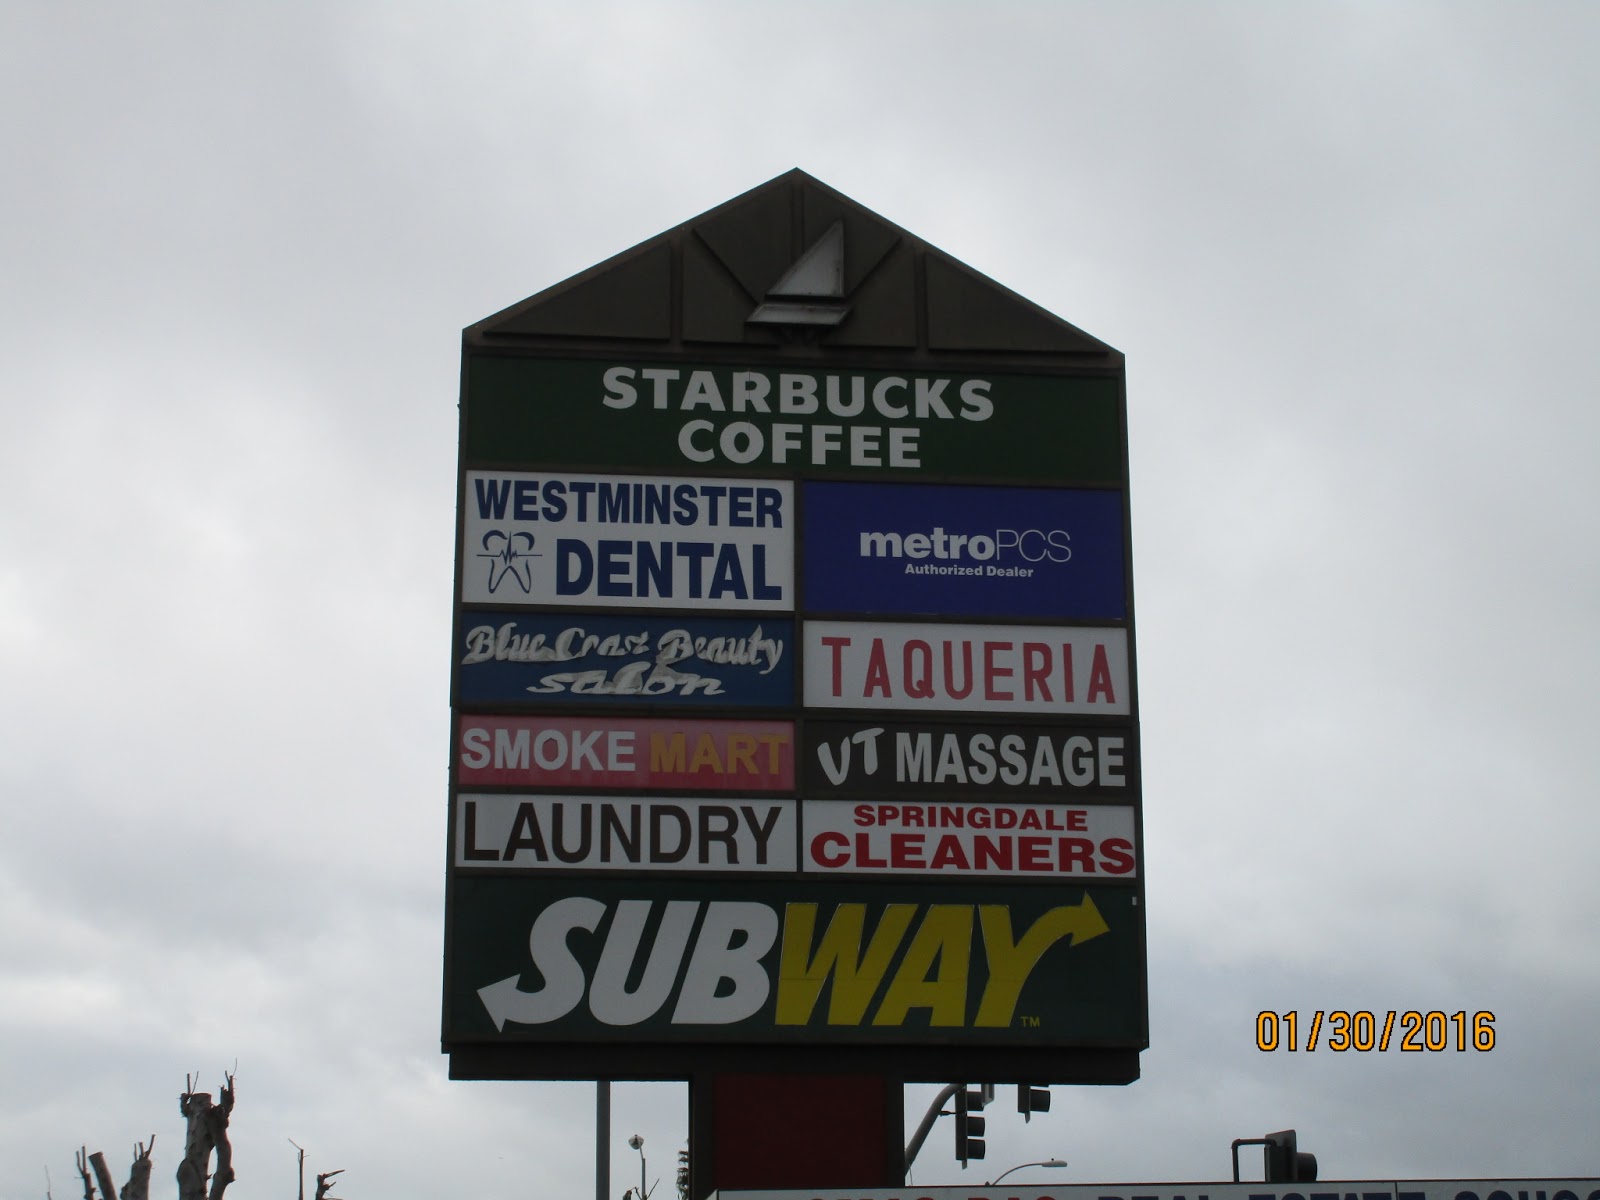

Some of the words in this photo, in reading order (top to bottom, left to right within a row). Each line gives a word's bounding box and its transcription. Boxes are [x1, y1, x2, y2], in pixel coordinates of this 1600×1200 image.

[602, 366, 994, 421] STARBUCKS
[678, 419, 921, 468] COFFEE
[474, 478, 783, 528] WESTMINSTER
[556, 538, 782, 600] DENTAL
[860, 527, 1072, 562] metroPCS
[905, 563, 983, 576] Authorized
[986, 565, 1034, 578] Dealer
[461, 622, 549, 664] Blue
[655, 624, 784, 675] Beauty
[821, 636, 1116, 704] TAQUERIA
[461, 728, 636, 772] SMOKE
[650, 731, 789, 775] MART
[816, 727, 885, 786] VT
[896, 731, 1126, 788] MASSAGE
[463, 801, 783, 865] LAUNDRY
[854, 804, 1088, 831] SPRINGDALE
[810, 831, 1135, 875] CLEANERS
[476, 890, 1110, 1033] SUBWAY
